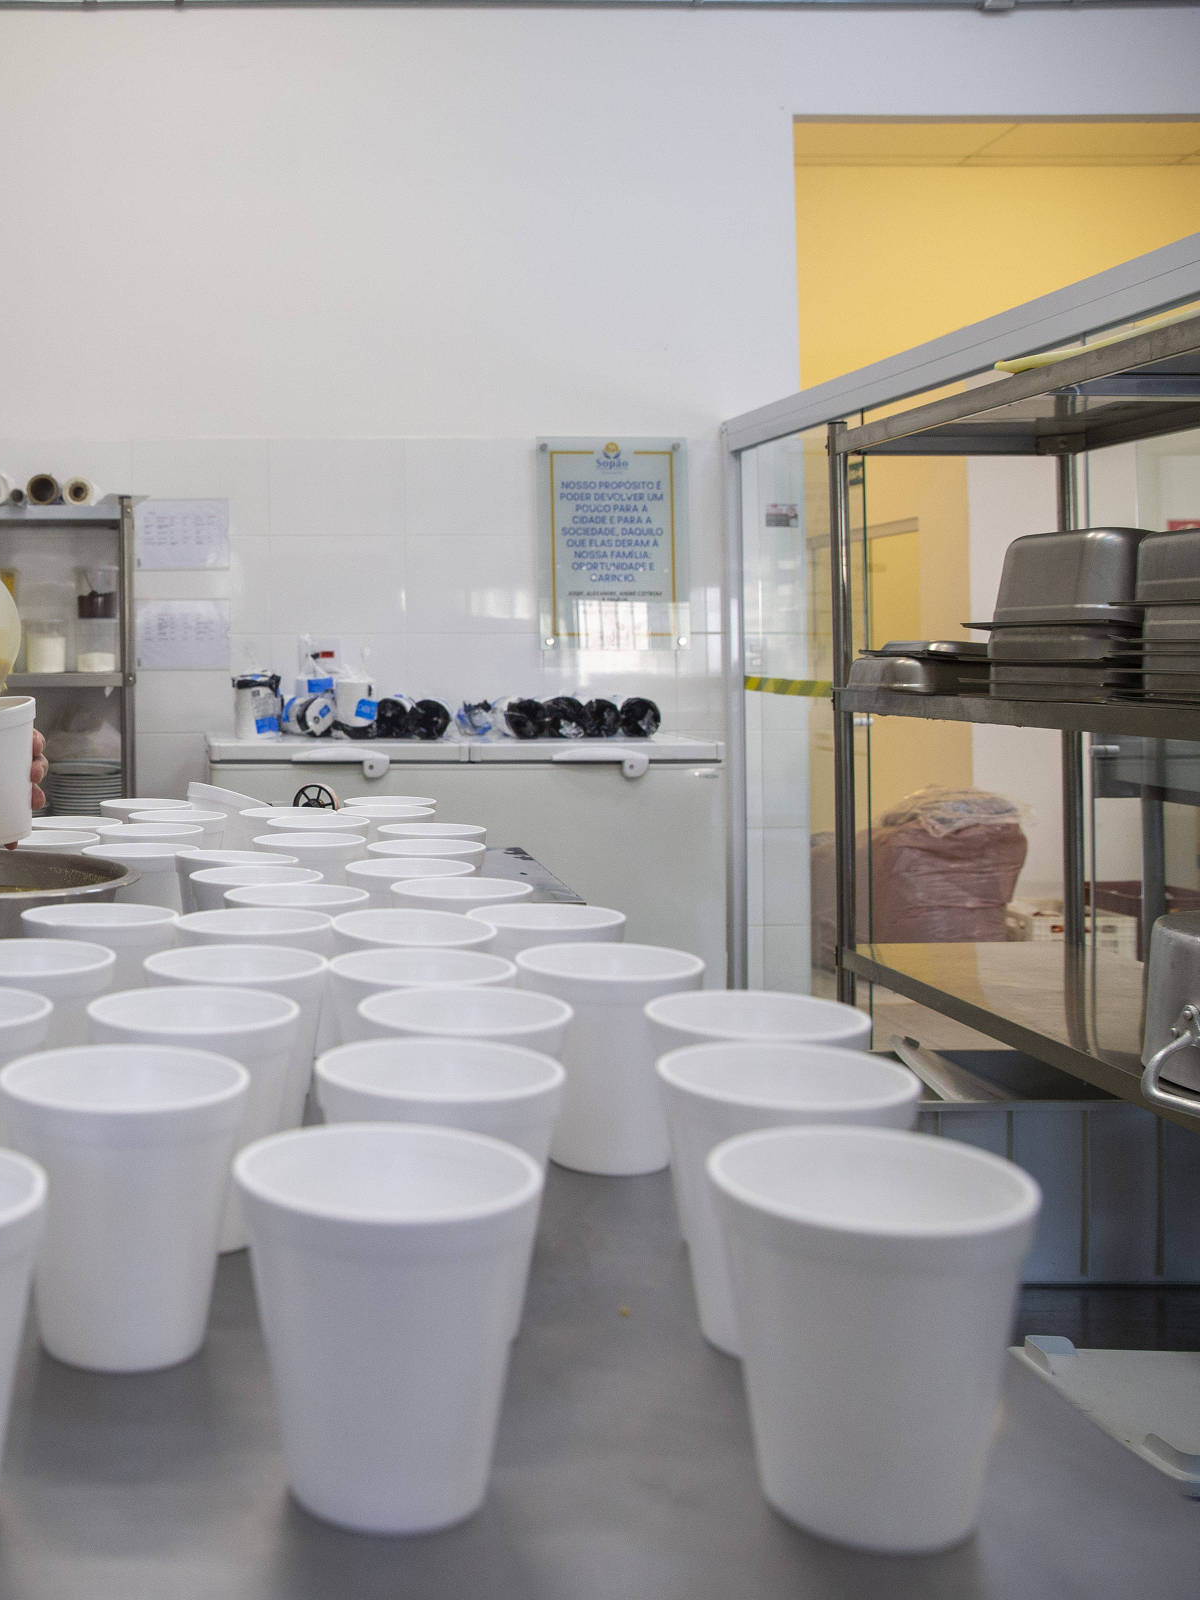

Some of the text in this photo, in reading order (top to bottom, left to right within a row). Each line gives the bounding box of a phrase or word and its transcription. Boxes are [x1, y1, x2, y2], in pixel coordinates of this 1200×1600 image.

[561, 481, 597, 490] NOSSO
[560, 492, 592, 502] PODER
[594, 492, 645, 502] DEVOLVER
[575, 504, 612, 513] POUCO
[613, 504, 639, 513] PARA
[572, 515, 607, 525] CIDADE
[617, 515, 643, 525] PARA
[621, 527, 664, 537] DAQUILO
[566, 539, 587, 548] QUE
[589, 539, 614, 548] ELAS
[615, 539, 651, 548] DERAM
[574, 551, 609, 559] NOSSA
